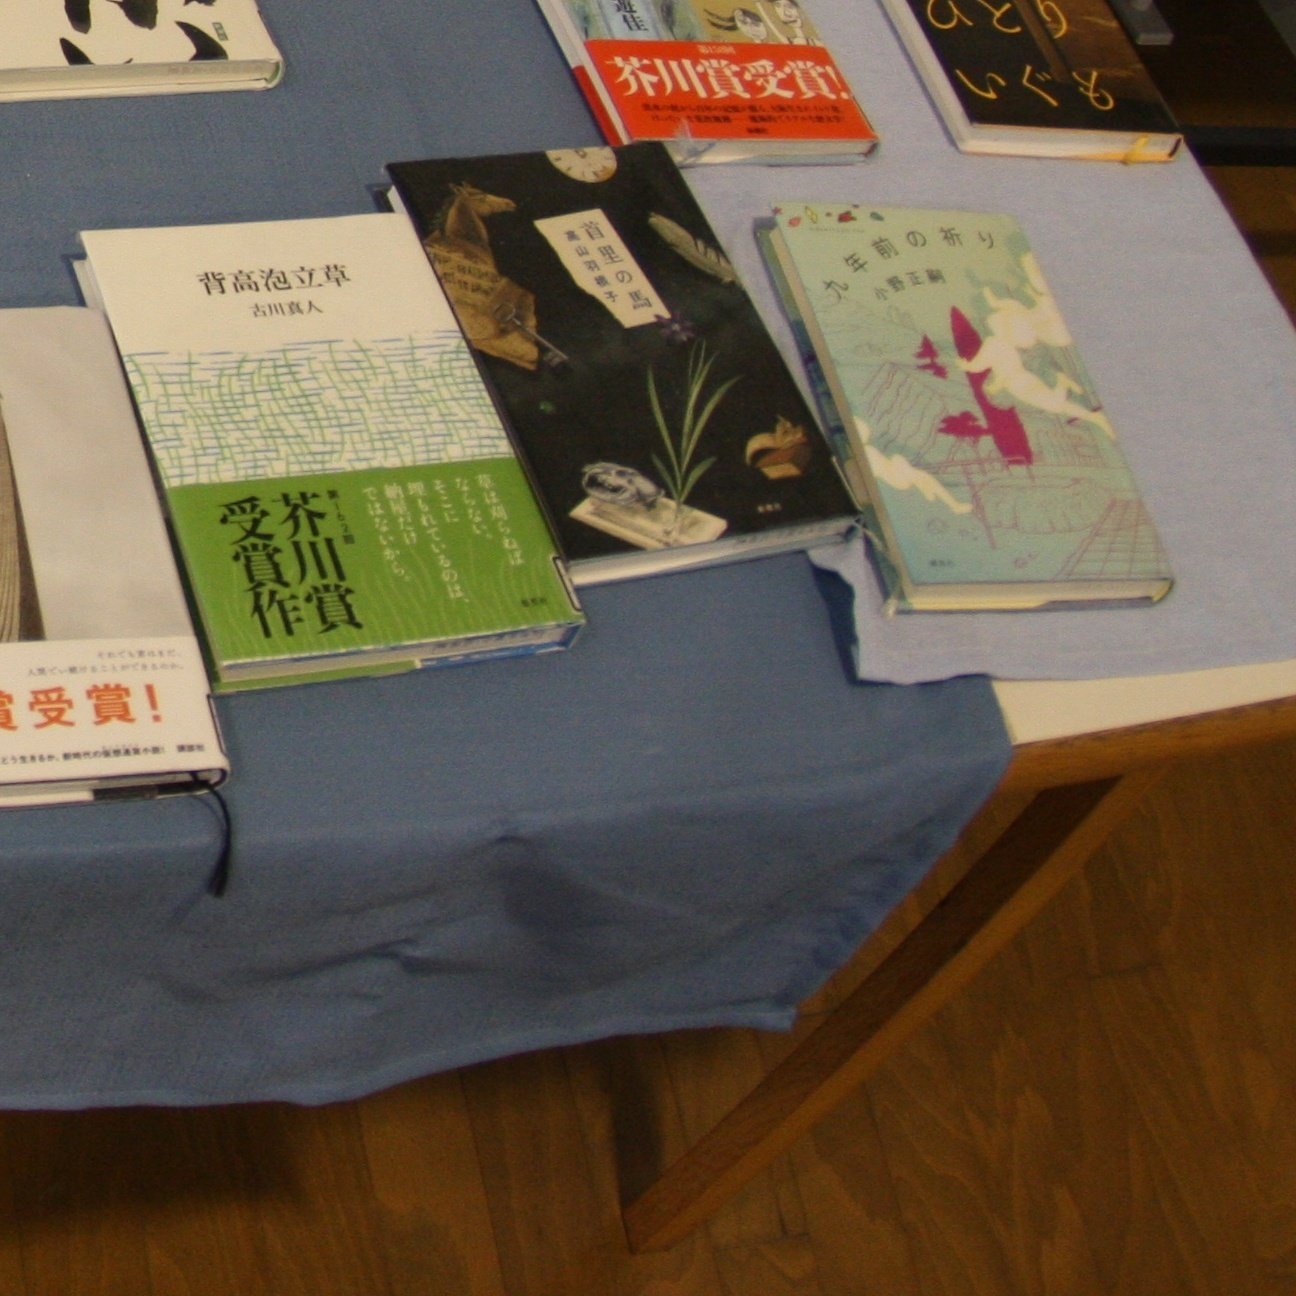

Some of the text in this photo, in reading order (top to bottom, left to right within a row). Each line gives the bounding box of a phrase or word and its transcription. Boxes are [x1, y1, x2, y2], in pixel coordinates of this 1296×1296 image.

[607, 56, 852, 100] 芥川賞受賞!
[956, 65, 1114, 110] いぐも
[198, 264, 352, 296] 背高泡立草
[581, 220, 652, 311] 首里の馬
[823, 225, 996, 302] 九年前の祈り
[251, 301, 323, 318] 古川真人
[219, 496, 304, 639] 受賞作
[272, 492, 363, 634] 芥川賞
